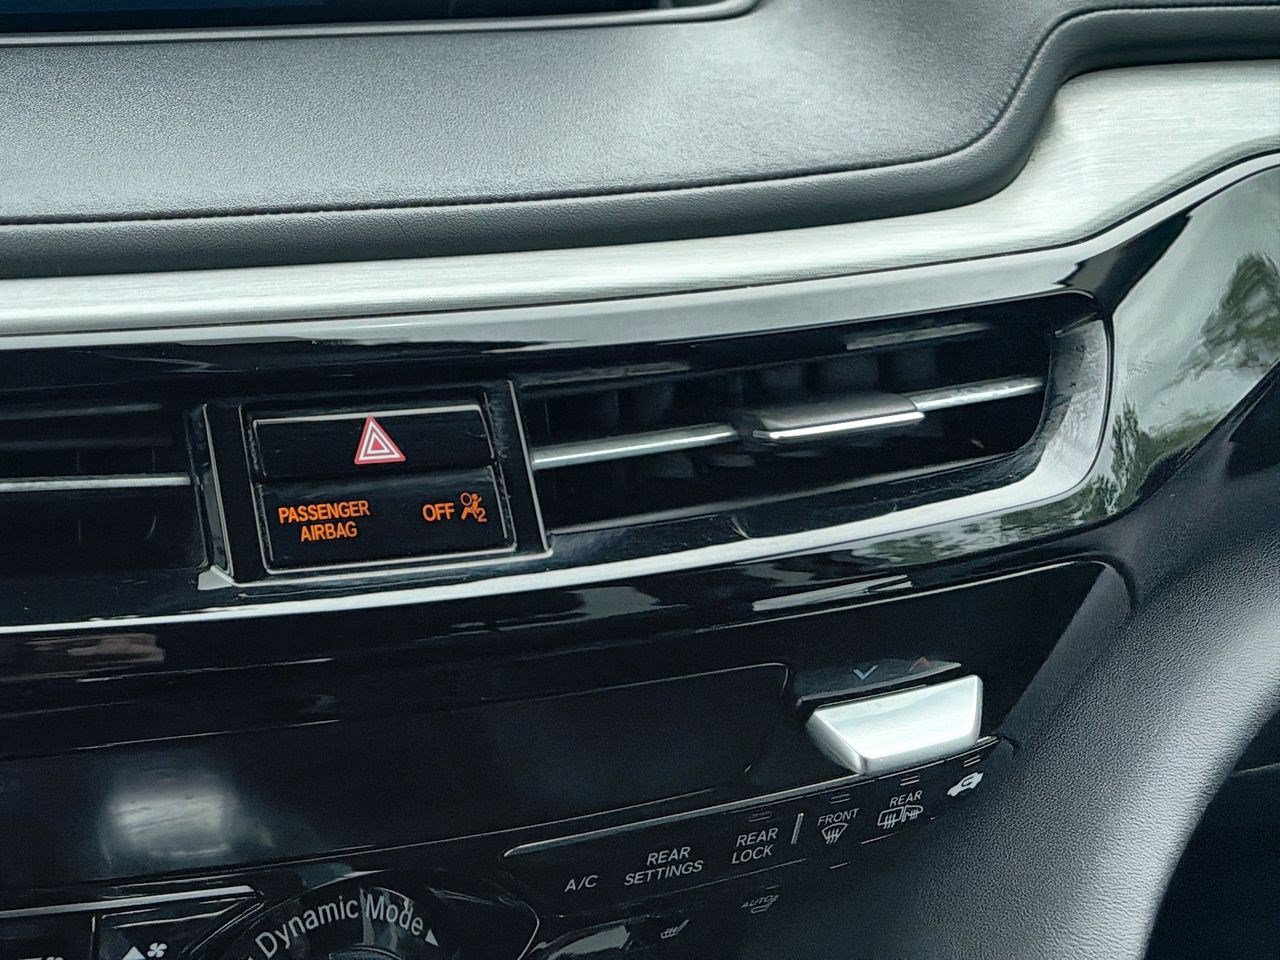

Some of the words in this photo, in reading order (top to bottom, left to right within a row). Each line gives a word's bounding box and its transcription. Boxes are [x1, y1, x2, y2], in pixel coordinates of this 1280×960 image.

[278, 500, 370, 523] PASSENGER
[422, 502, 455, 521] OFF
[300, 521, 358, 542] AIRBAG
[889, 790, 923, 807] REAR
[817, 807, 860, 826] FRONT
[735, 827, 779, 848] REAR
[646, 846, 692, 866] REAR
[731, 844, 774, 865] LOCK
[564, 874, 599, 892] A/C
[623, 860, 704, 886] SETTINGS
[255, 895, 360, 959] Dynamic
[365, 893, 424, 936] Mode
